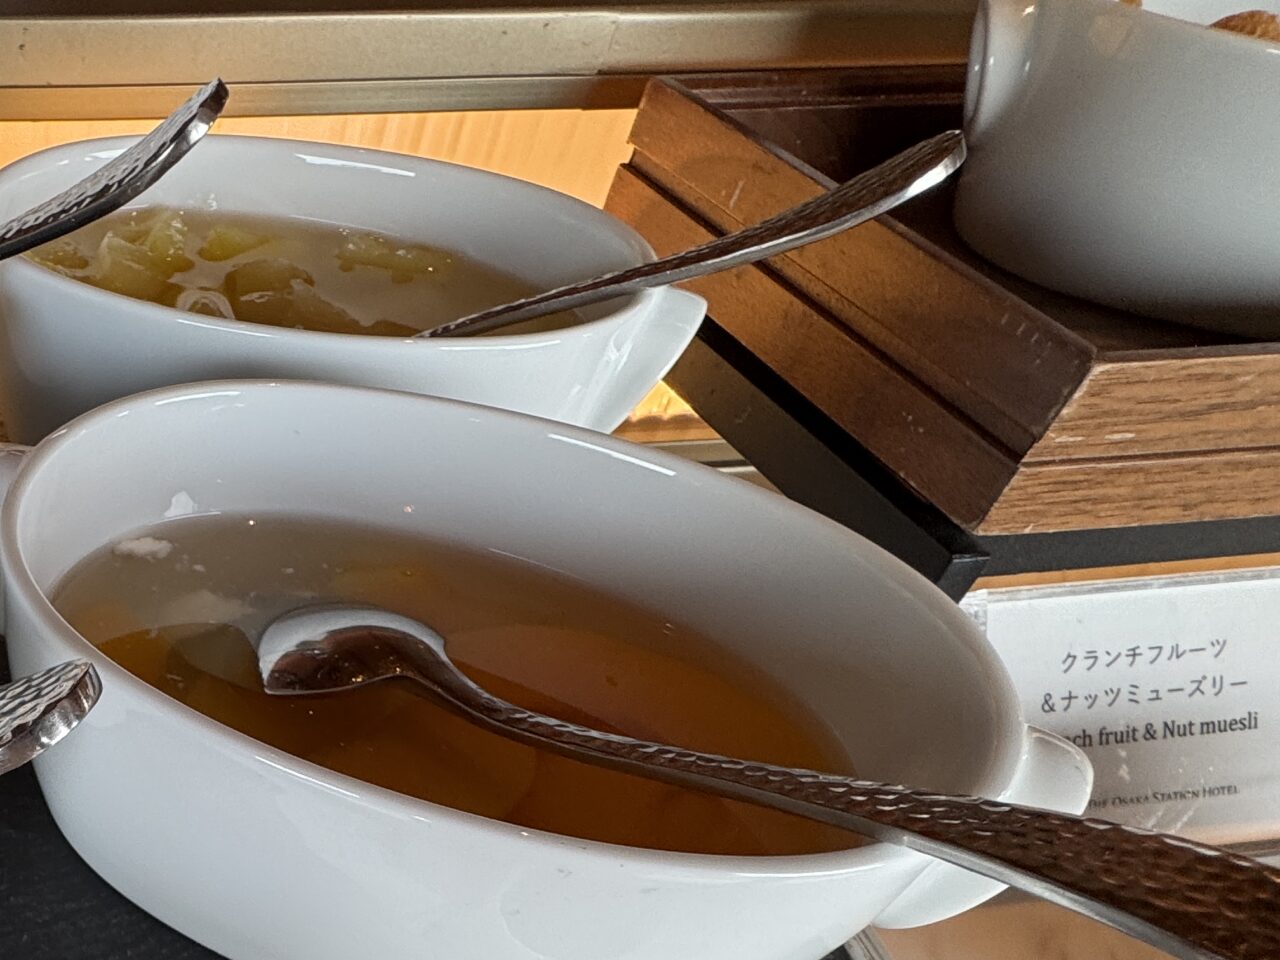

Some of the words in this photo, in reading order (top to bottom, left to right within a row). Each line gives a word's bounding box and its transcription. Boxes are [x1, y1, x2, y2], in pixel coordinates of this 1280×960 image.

[1061, 638, 1228, 675] クランチフルーツ
[1098, 724, 1139, 746] fruit
[1142, 722, 1158, 742] &
[1162, 719, 1196, 740] Nut
[1198, 710, 1260, 736] muesli
[1202, 784, 1240, 799] HOTEL
